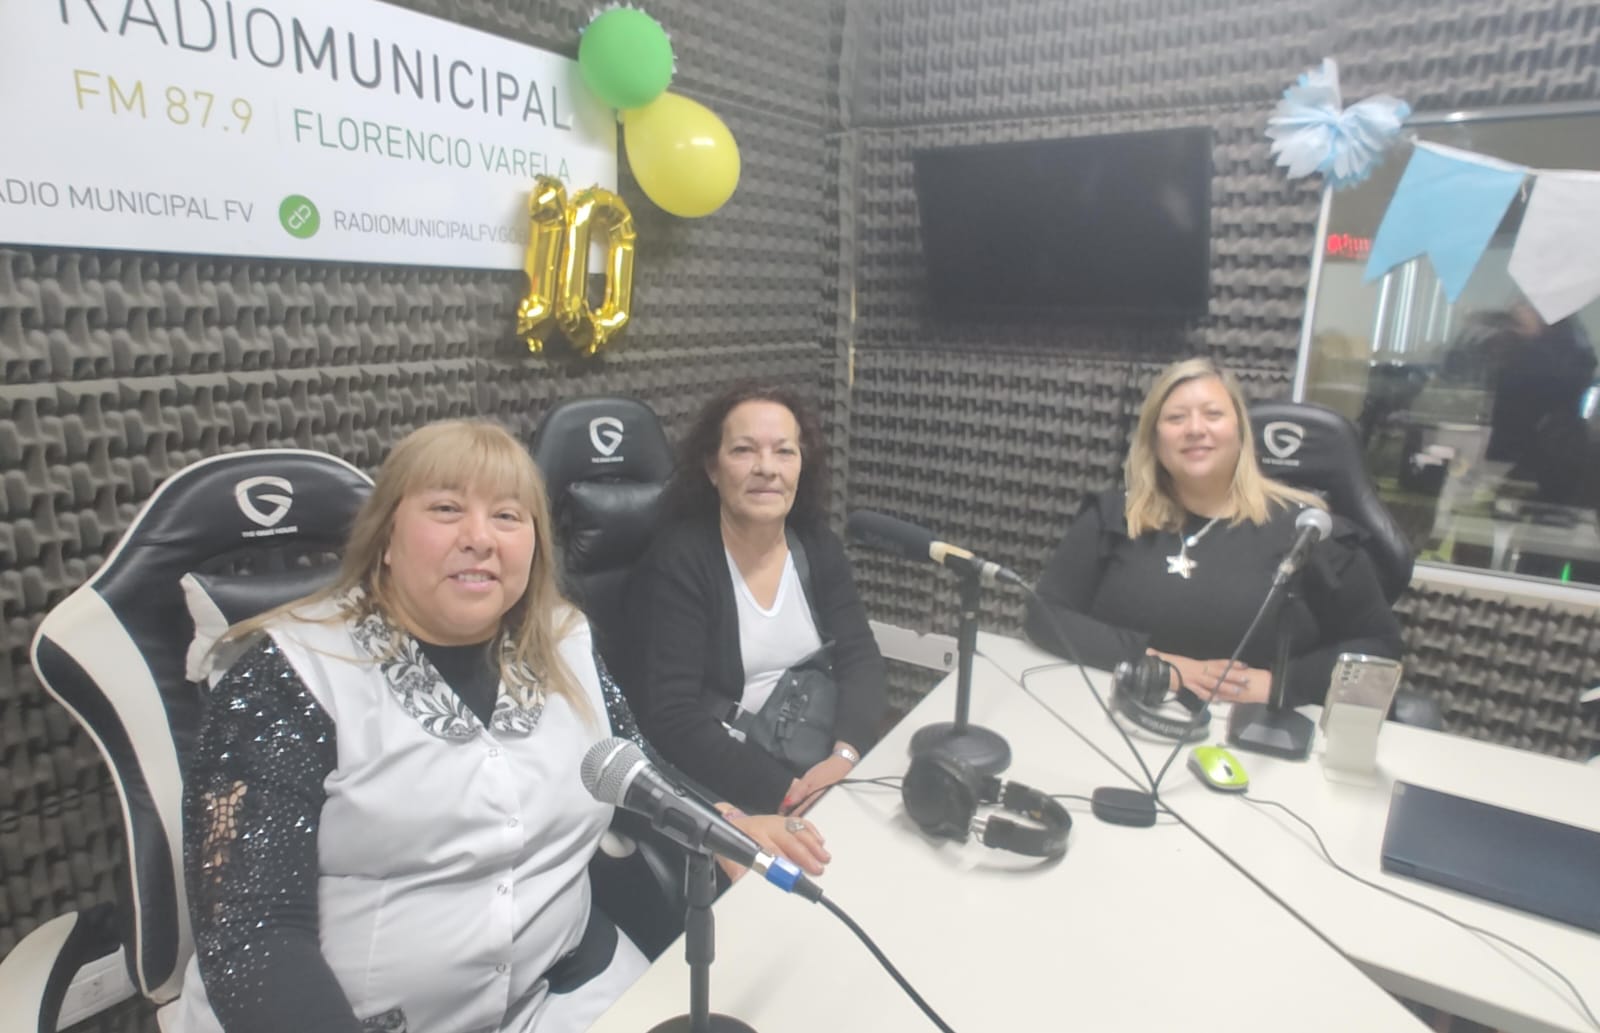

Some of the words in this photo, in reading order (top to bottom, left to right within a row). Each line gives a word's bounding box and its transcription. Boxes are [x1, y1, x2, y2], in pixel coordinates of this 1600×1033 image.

[73, 69, 147, 119] FM
[165, 85, 252, 134] 87.9
[294, 108, 472, 168] FLORENCIO
[0, 178, 60, 208] DIO
[68, 184, 220, 221] MUNICIPAL
[224, 199, 254, 223] FV
